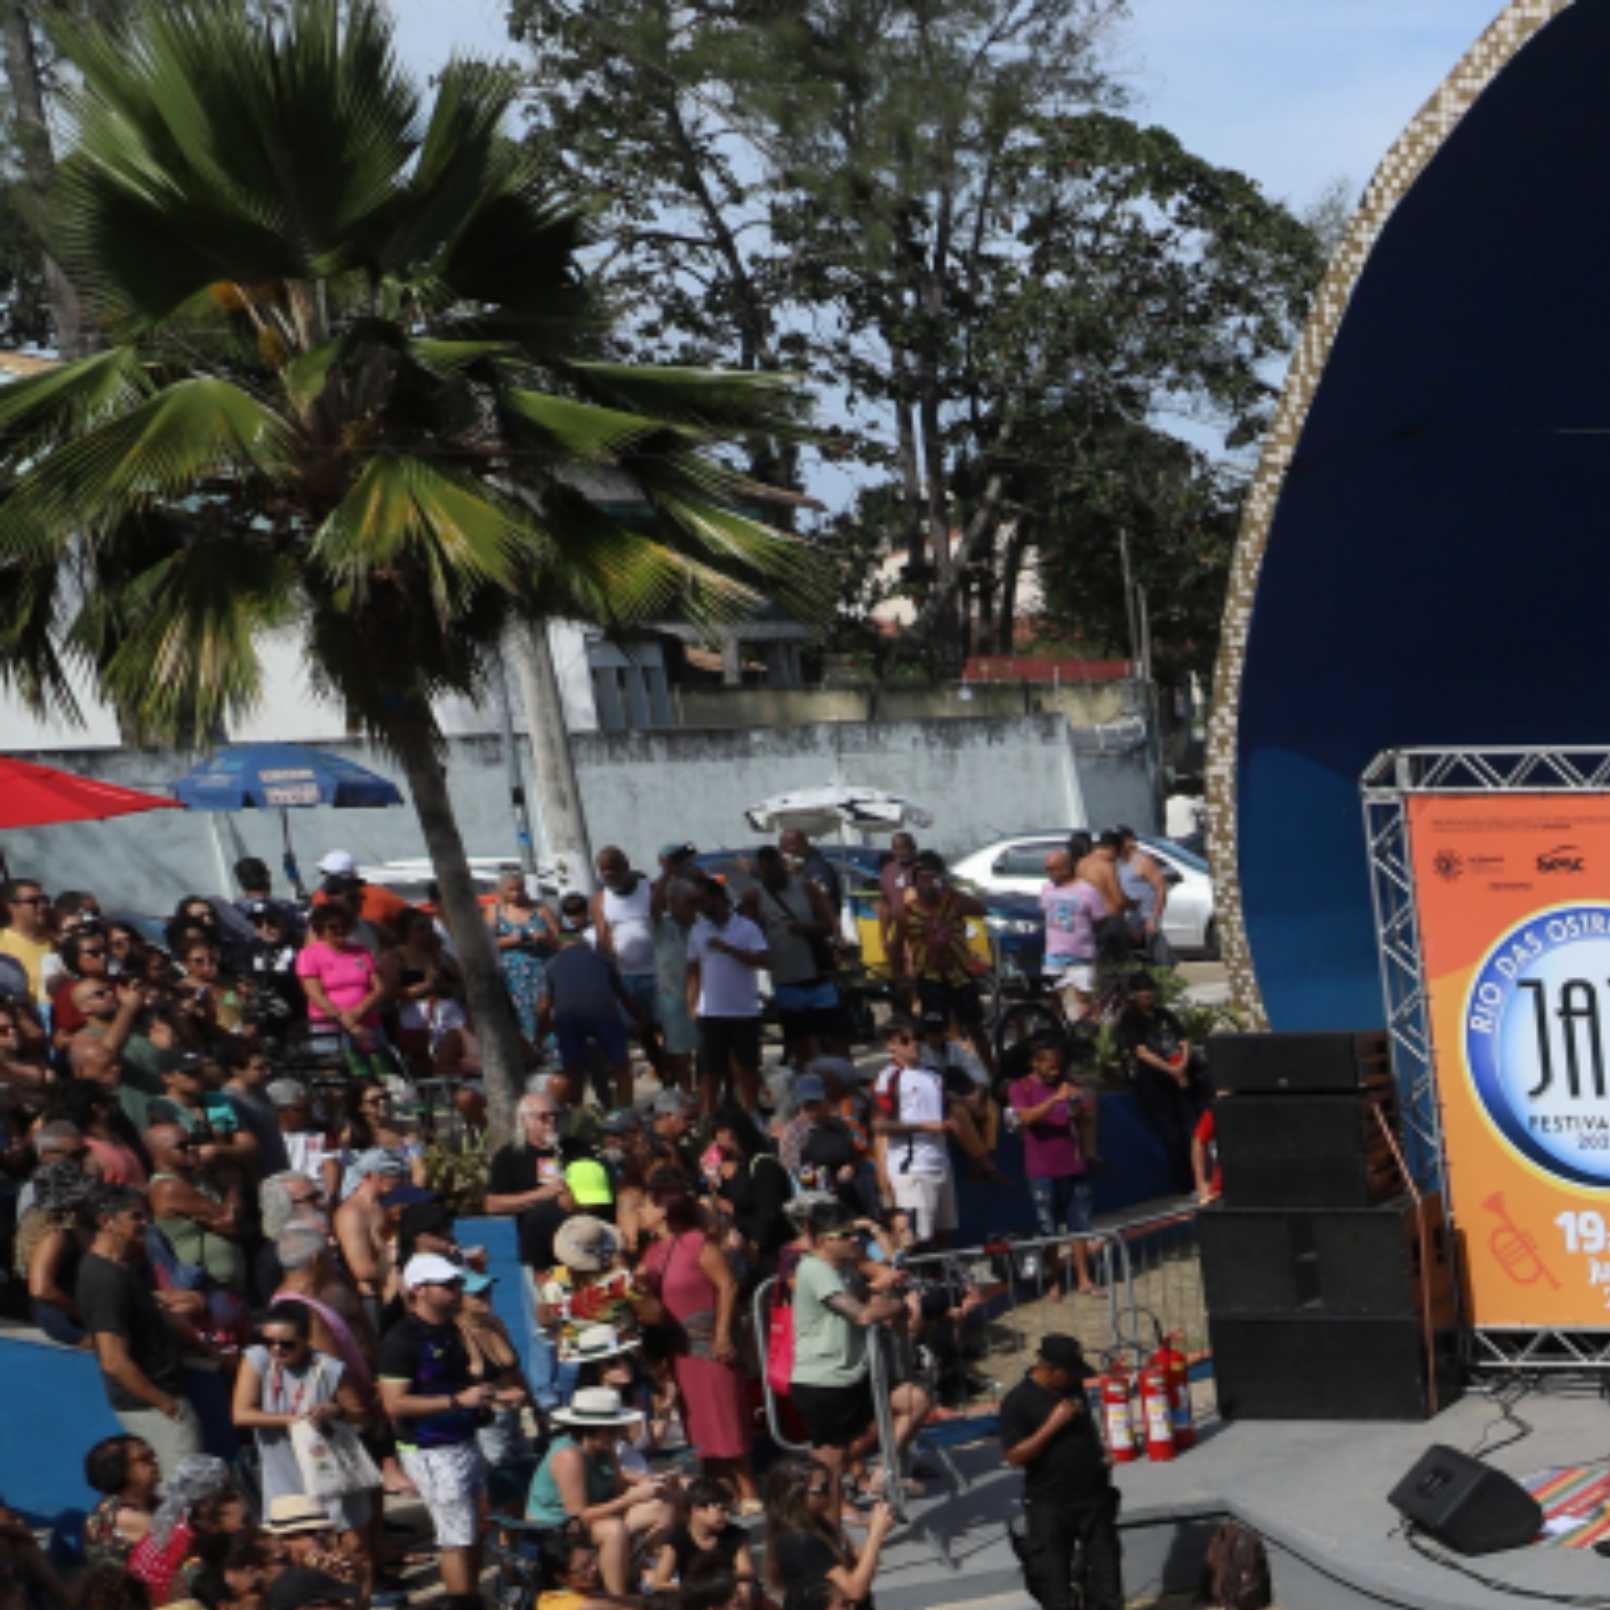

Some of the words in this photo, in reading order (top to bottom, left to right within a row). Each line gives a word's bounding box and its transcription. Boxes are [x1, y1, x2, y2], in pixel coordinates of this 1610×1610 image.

[1470, 982, 1501, 1034] RIO
[1494, 932, 1543, 979] DAS
[1554, 1210, 1605, 1254] 19
